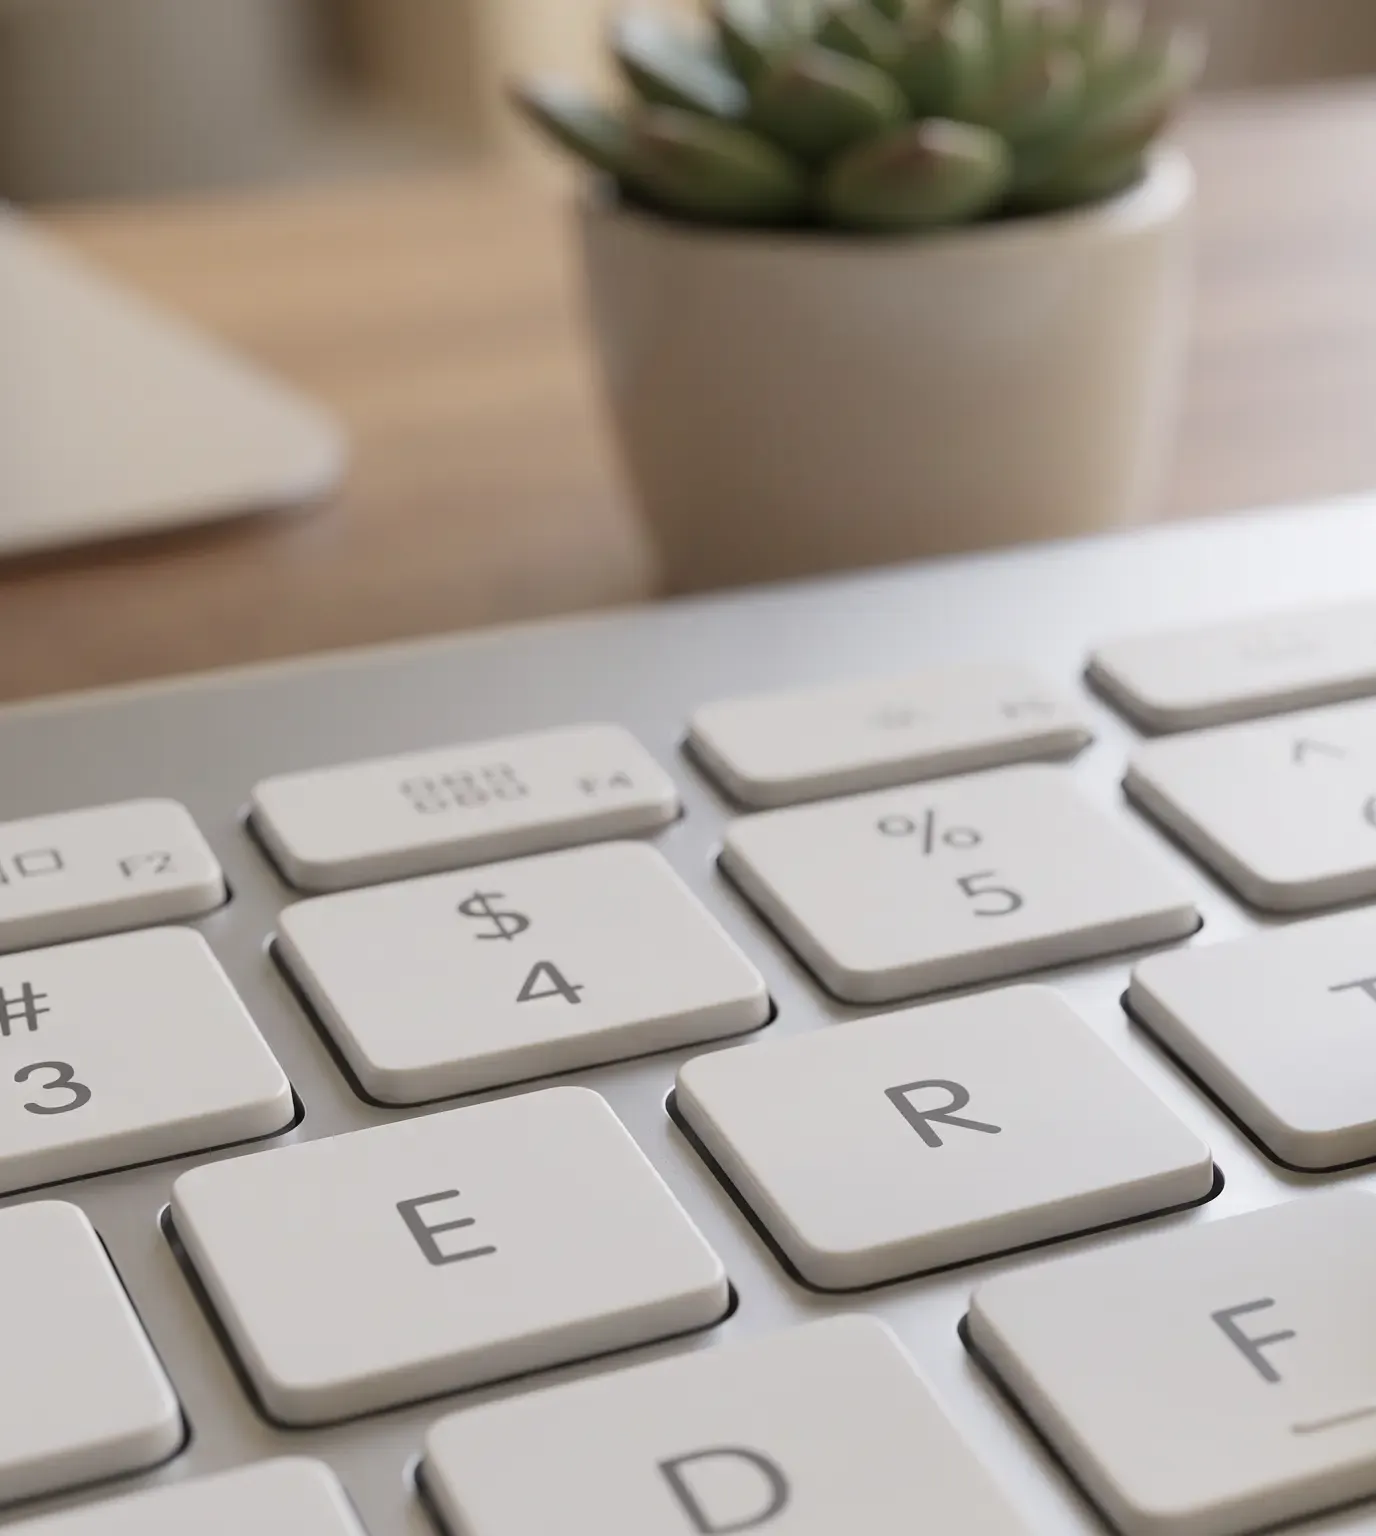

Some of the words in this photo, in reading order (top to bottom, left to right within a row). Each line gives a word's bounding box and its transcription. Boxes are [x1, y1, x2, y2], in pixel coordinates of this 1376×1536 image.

[876, 808, 982, 857] %
[117, 852, 175, 879] F2
[457, 890, 531, 942] $
[955, 871, 1024, 918] 5
[0, 981, 51, 1037] #
[515, 960, 585, 1005] 4
[13, 1060, 92, 1115] 3
[883, 1078, 1002, 1149] R
[395, 1189, 498, 1267] E
[1209, 1297, 1297, 1385] F
[656, 1445, 791, 1536] D
